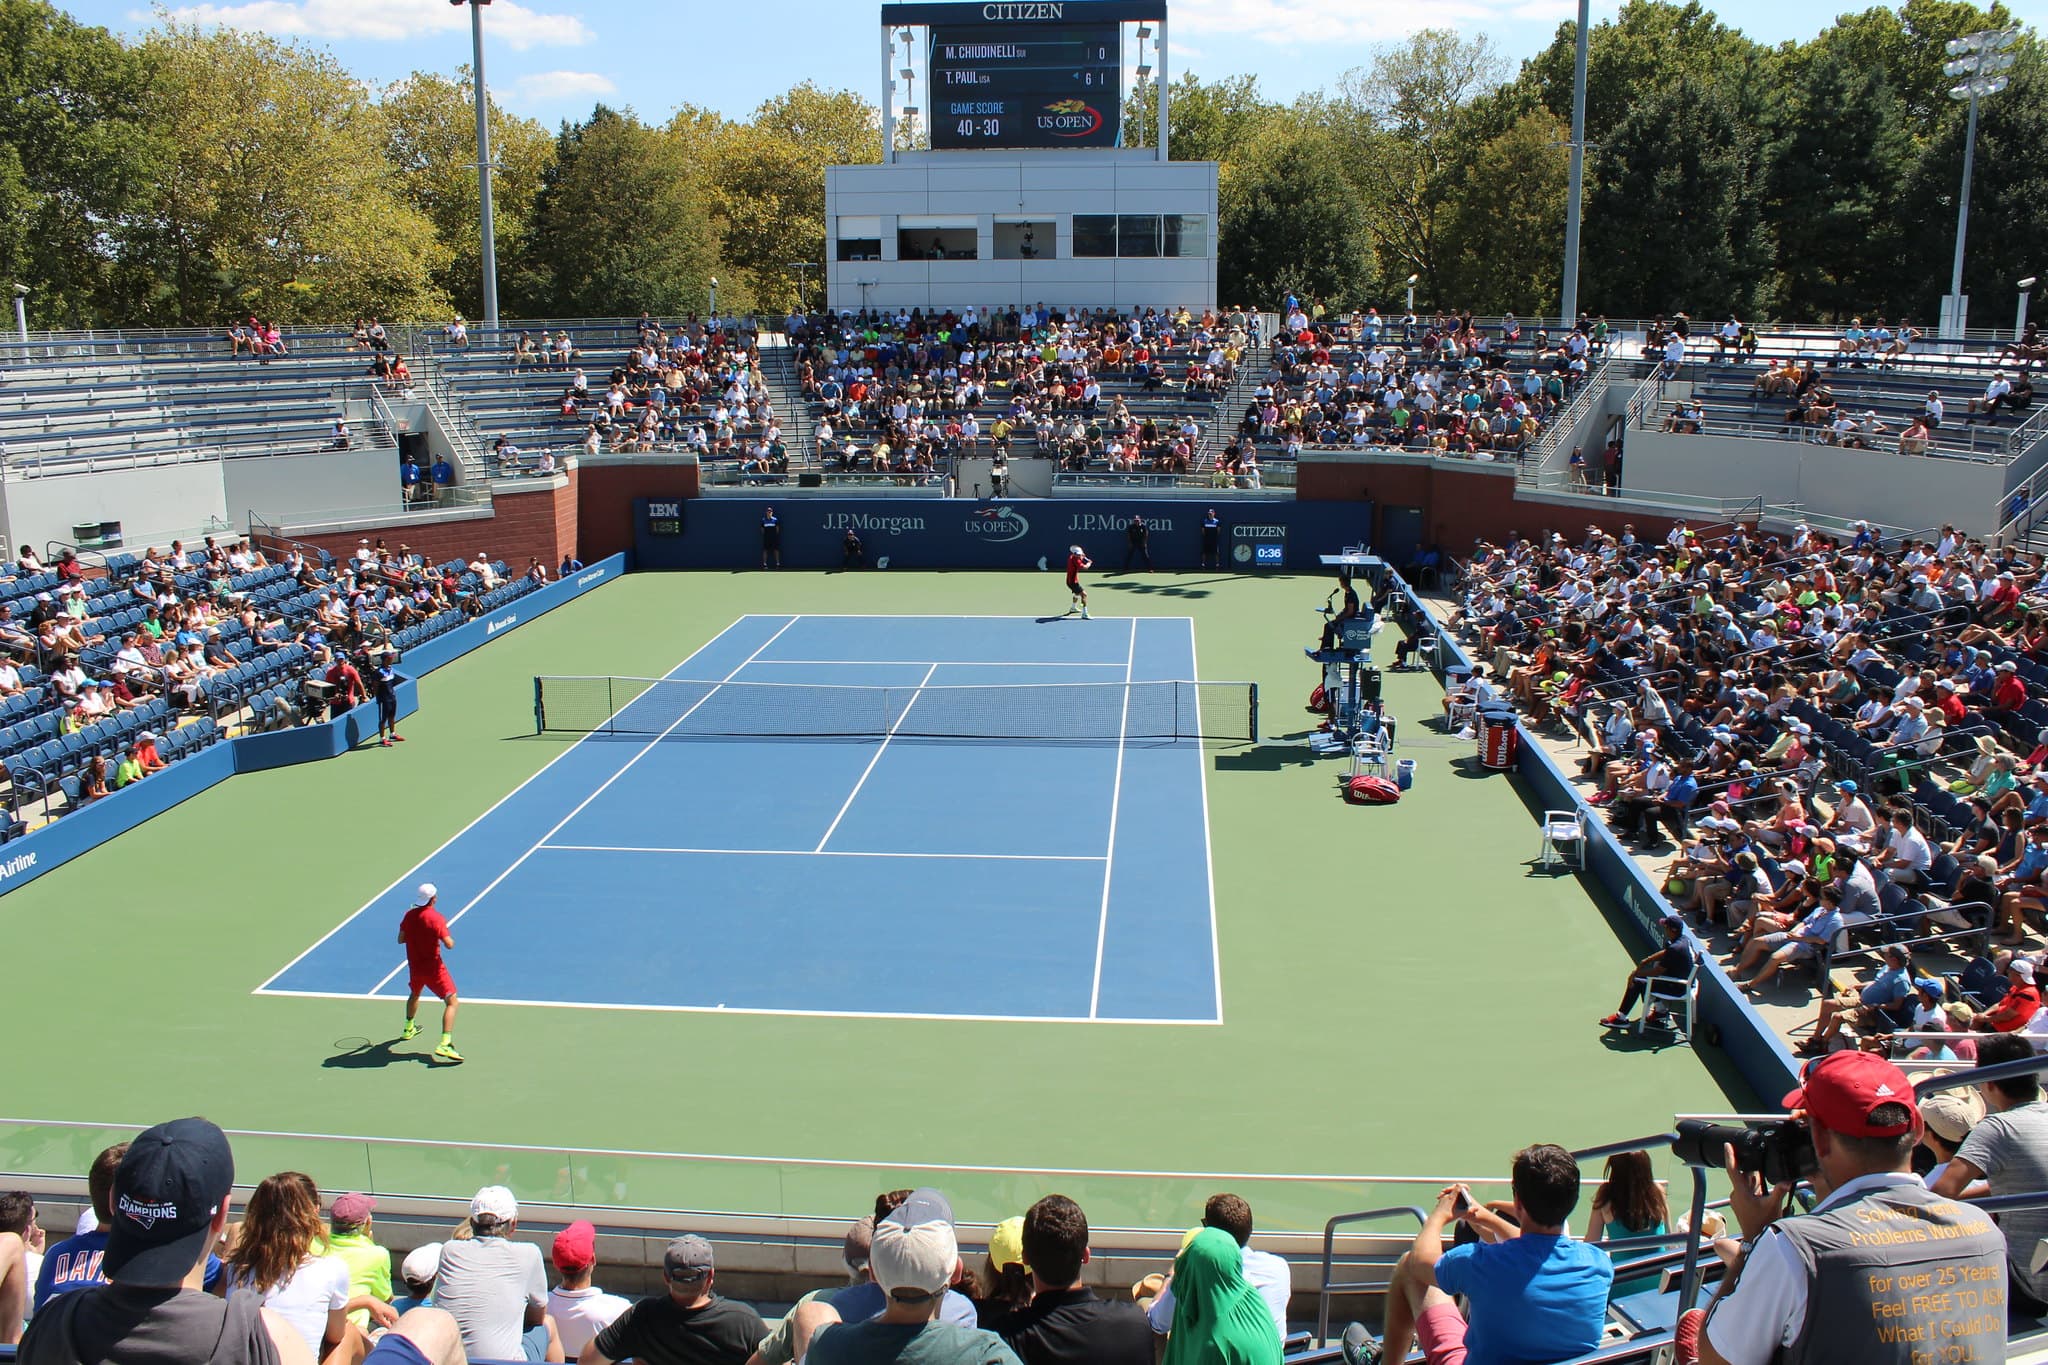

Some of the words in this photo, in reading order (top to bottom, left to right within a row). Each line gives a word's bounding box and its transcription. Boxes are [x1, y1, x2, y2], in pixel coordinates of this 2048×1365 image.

[983, 3, 1064, 20] CITIZEN
[946, 46, 957, 59] M.
[958, 45, 1016, 59] CHIUDINELLI
[1099, 47, 1105, 60] 0
[946, 71, 954, 84] T.
[955, 71, 978, 84] PAUL
[979, 75, 991, 84] USA
[1085, 73, 1092, 85] 6
[951, 102, 975, 114] GAME
[976, 102, 1005, 114] SCORE
[957, 119, 973, 136] 40
[983, 119, 999, 136] 30
[1037, 116, 1053, 128] US
[1055, 115, 1093, 128] OPEN
[649, 503, 679, 517] IBM
[965, 520, 981, 533] US
[982, 520, 1020, 533] OPEN
[1233, 525, 1286, 537] CITIZEN
[1257, 548, 1282, 559] 0:36
[1497, 730, 1509, 766] Wilson
[0, 851, 38, 881] Airline
[119, 1196, 177, 1219] CHAMPIONS
[1849, 1226, 1928, 1247] Problems
[1869, 1275, 1893, 1293] for
[1898, 1270, 1932, 1290] over
[1936, 1266, 1956, 1285] 25
[1872, 1298, 1907, 1319] Feel
[1912, 1293, 1952, 1314] FREE
[1953, 1290, 1979, 1310] TO
[1877, 1323, 1926, 1343] What
[1928, 1321, 1937, 1339] I
[1940, 1315, 1982, 1338] Could
[1985, 1314, 2001, 1333] Do
[1911, 1350, 1934, 1365] for
